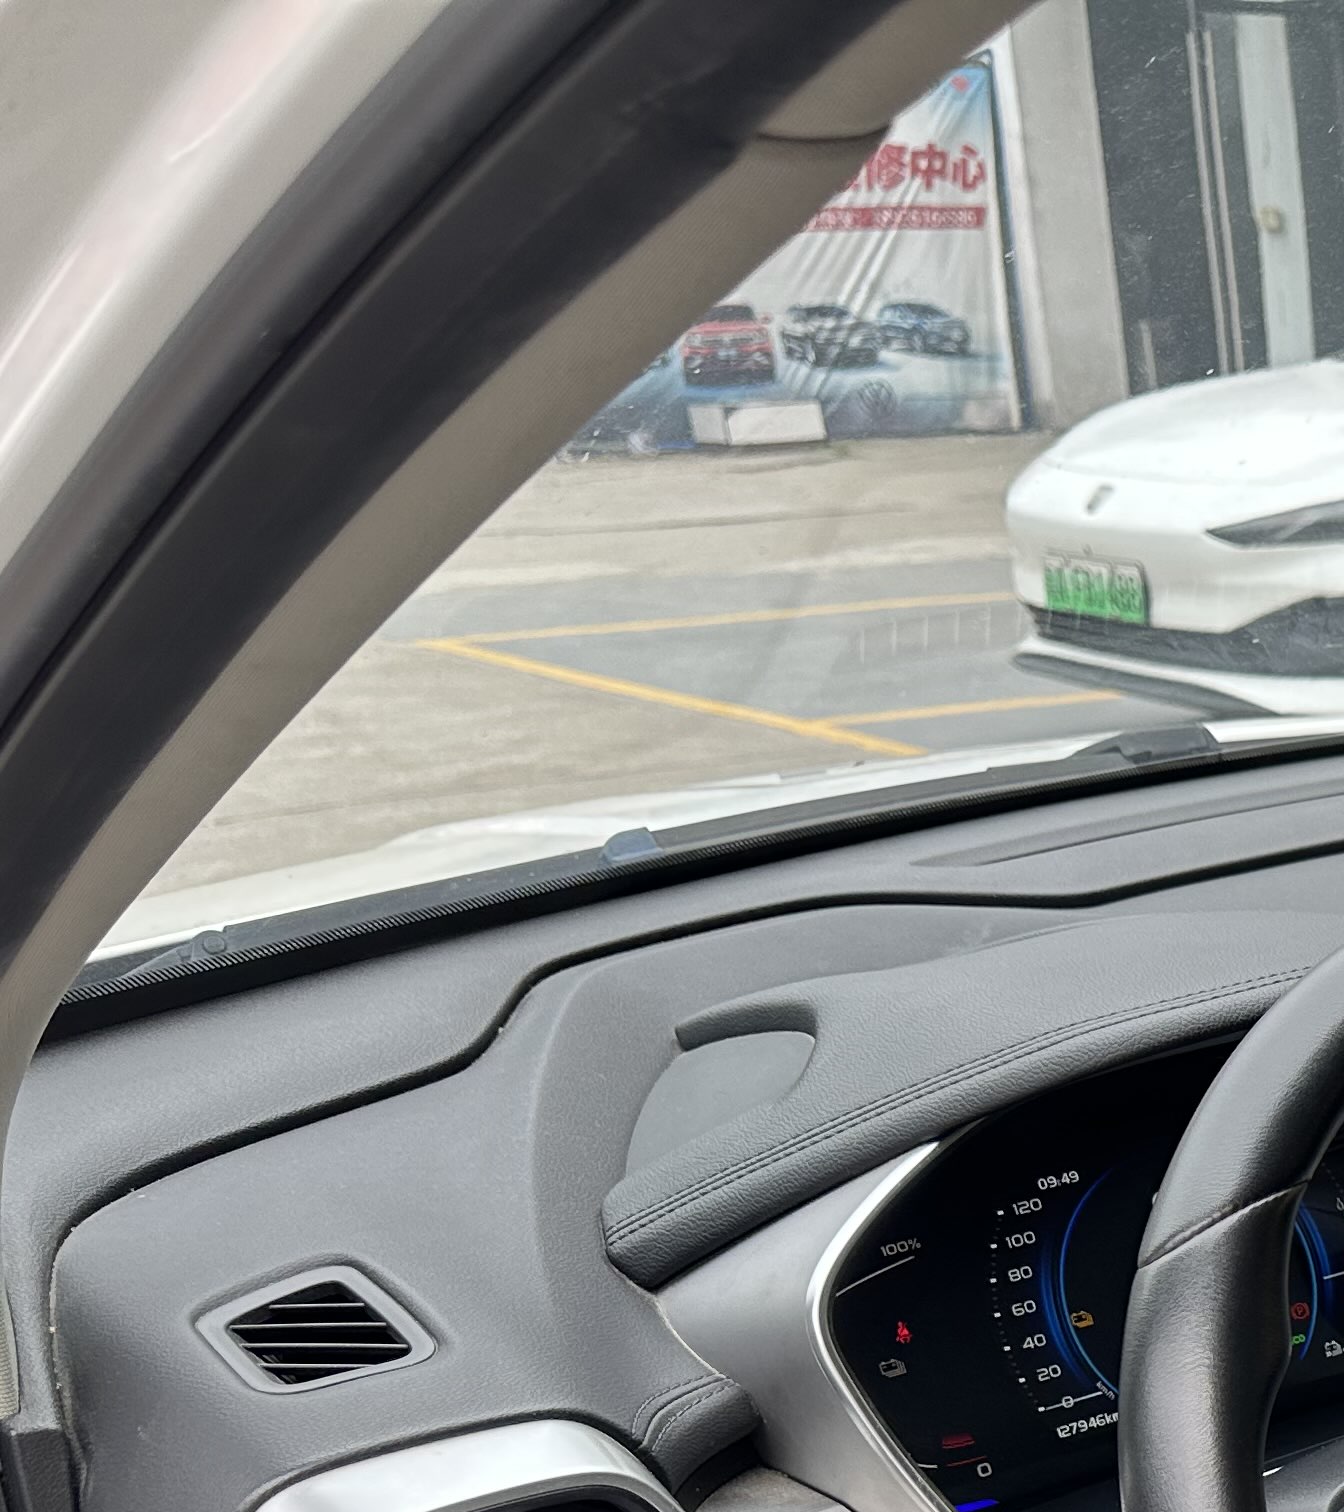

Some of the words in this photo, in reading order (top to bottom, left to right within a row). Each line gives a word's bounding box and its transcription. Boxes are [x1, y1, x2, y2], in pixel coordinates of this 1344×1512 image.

[848, 143, 987, 192] 修中心
[1037, 1170, 1080, 1191] 09:49
[1012, 1198, 1043, 1216] 120
[879, 1237, 922, 1257] 100%
[1005, 1231, 1037, 1249] 100
[1008, 1265, 1033, 1283] 80
[1011, 1300, 1037, 1317] 60
[1022, 1333, 1047, 1350] 40
[1036, 1364, 1061, 1382] 20
[1096, 1380, 1115, 1400] km/h
[976, 1462, 993, 1478] 0
